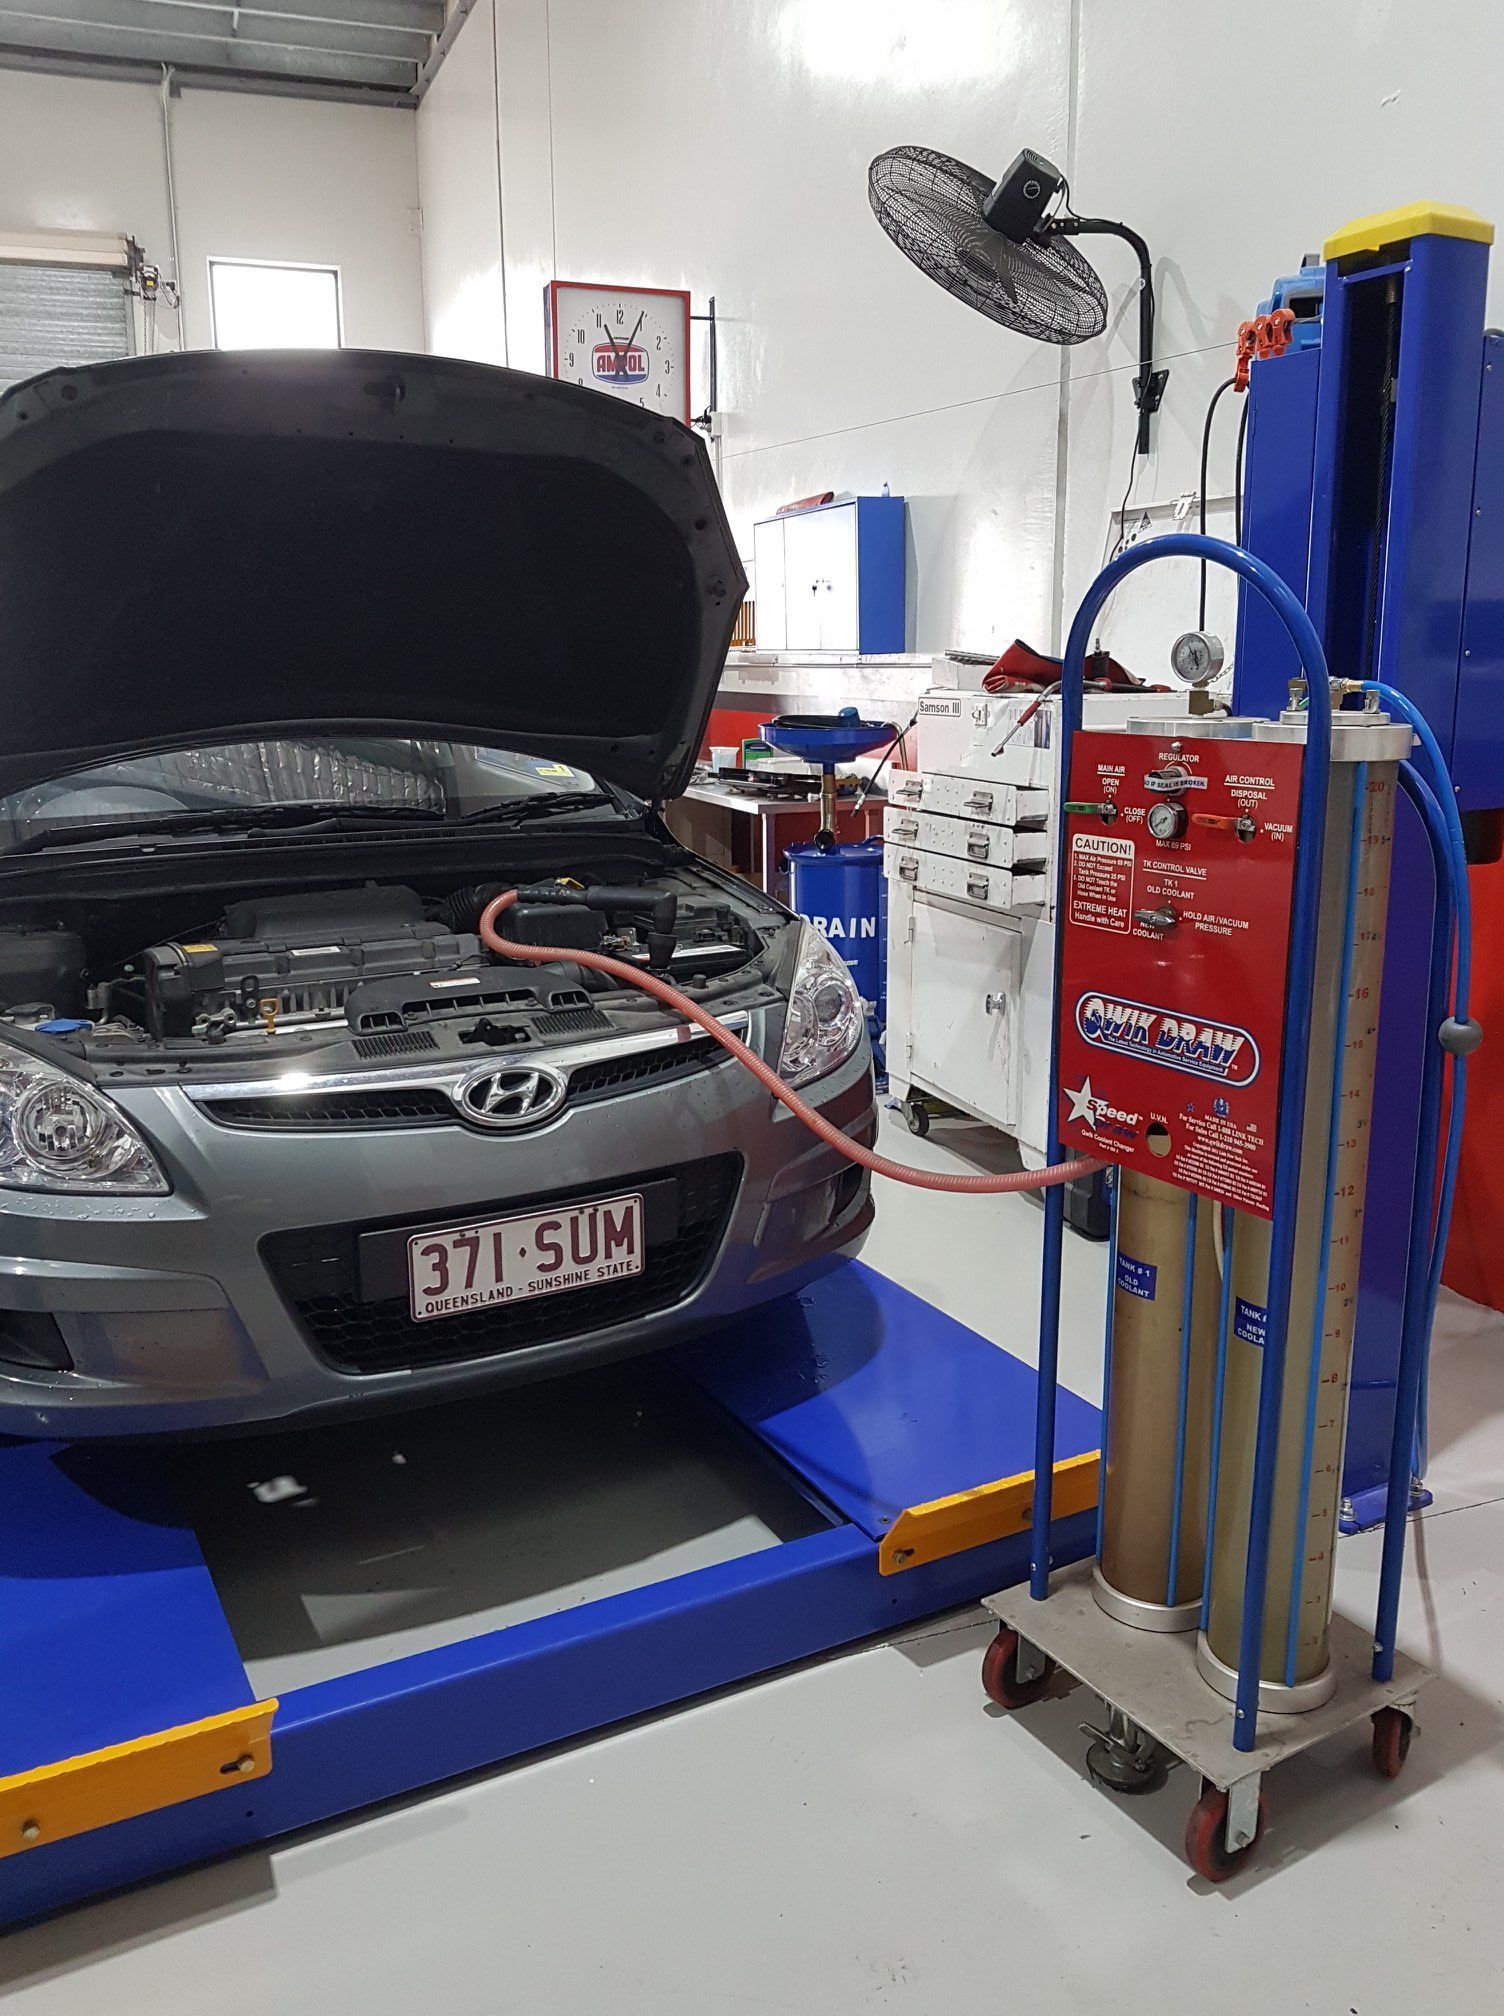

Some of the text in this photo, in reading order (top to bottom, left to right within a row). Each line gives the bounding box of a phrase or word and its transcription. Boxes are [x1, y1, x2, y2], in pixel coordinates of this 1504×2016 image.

[617, 310, 624, 325] 12
[578, 330, 585, 344] 10
[920, 701, 960, 714] Samson III
[1159, 753, 1200, 763] REGULATOR
[1098, 764, 1126, 773] MAIN AIR
[1102, 778, 1120, 786] OPEN
[1225, 775, 1275, 786] AIR CONTROL
[1104, 786, 1117, 795] (ON)
[1369, 781, 1385, 793] 20
[1231, 790, 1268, 800] DISPOSAL
[1238, 799, 1259, 809] (OUT)
[1124, 807, 1146, 816] CLOSE
[1126, 815, 1143, 825] (OFF)
[1264, 822, 1293, 833] VACUUM
[1271, 833, 1285, 842] (IN)
[1367, 835, 1379, 845] 19
[1075, 838, 1131, 855] CAUTION!
[1156, 840, 1170, 849] MAX
[1180, 842, 1192, 851] PSI
[1097, 856, 1117, 865] Pressure
[1079, 868, 1089, 876] Tank
[1090, 870, 1110, 879] Pressure
[1097, 864, 1113, 872] Exceed
[1143, 860, 1207, 876] TK CONTROL VALVE
[1097, 878, 1110, 886] Touch
[1164, 879, 1173, 887] TK
[1086, 884, 1103, 892] Coolant
[1147, 885, 1195, 900] OLD COOLANT
[1363, 887, 1376, 897] 18
[1073, 901, 1128, 918] EXTREME HEAT
[1075, 912, 1125, 928] Handle with Care
[1183, 911, 1202, 921] HOLD
[1133, 928, 1164, 941] COOLANT
[1195, 922, 1233, 936] PRESSURE
[1361, 932, 1372, 941] 17
[1355, 988, 1370, 1000] 16
[1155, 1017, 1246, 1067] DRAW
[1352, 1040, 1364, 1050] 15
[1116, 1038, 1129, 1046] Latest
[1158, 1050, 1181, 1061] Automotive
[1182, 1056, 1199, 1066] Service
[1199, 1061, 1224, 1072] Equipment
[1349, 1090, 1360, 1099] 14
[1205, 1115, 1220, 1124] MADE
[1227, 1121, 1237, 1129] USA
[1179, 1113, 1188, 1122] For
[1189, 1116, 1206, 1127] Service
[1207, 1122, 1217, 1131] Call
[1247, 1135, 1264, 1146] TECH
[1186, 1123, 1195, 1131] For
[1195, 1126, 1208, 1136] Sales
[1209, 1131, 1219, 1139] Call
[1082, 1129, 1093, 1139] Qwik
[1094, 1133, 1113, 1145] Coolant
[1114, 1140, 1135, 1153] Changer
[1341, 1185, 1355, 1197] 12
[1339, 1236, 1349, 1246] 11
[1119, 1257, 1136, 1273] TANK
[1124, 1275, 1139, 1286] OLD
[425, 1285, 514, 1314] QUEENSLAND
[528, 1269, 591, 1293] SUNSHINE
[597, 1261, 633, 1278] STATE
[1118, 1278, 1150, 1298] COOLANT
[1336, 1283, 1346, 1293] 10
[1241, 1305, 1262, 1321] TANK
[1246, 1324, 1266, 1337] NEW
[1237, 1328, 1265, 1345] COOLA
[1332, 1373, 1339, 1384] 8
